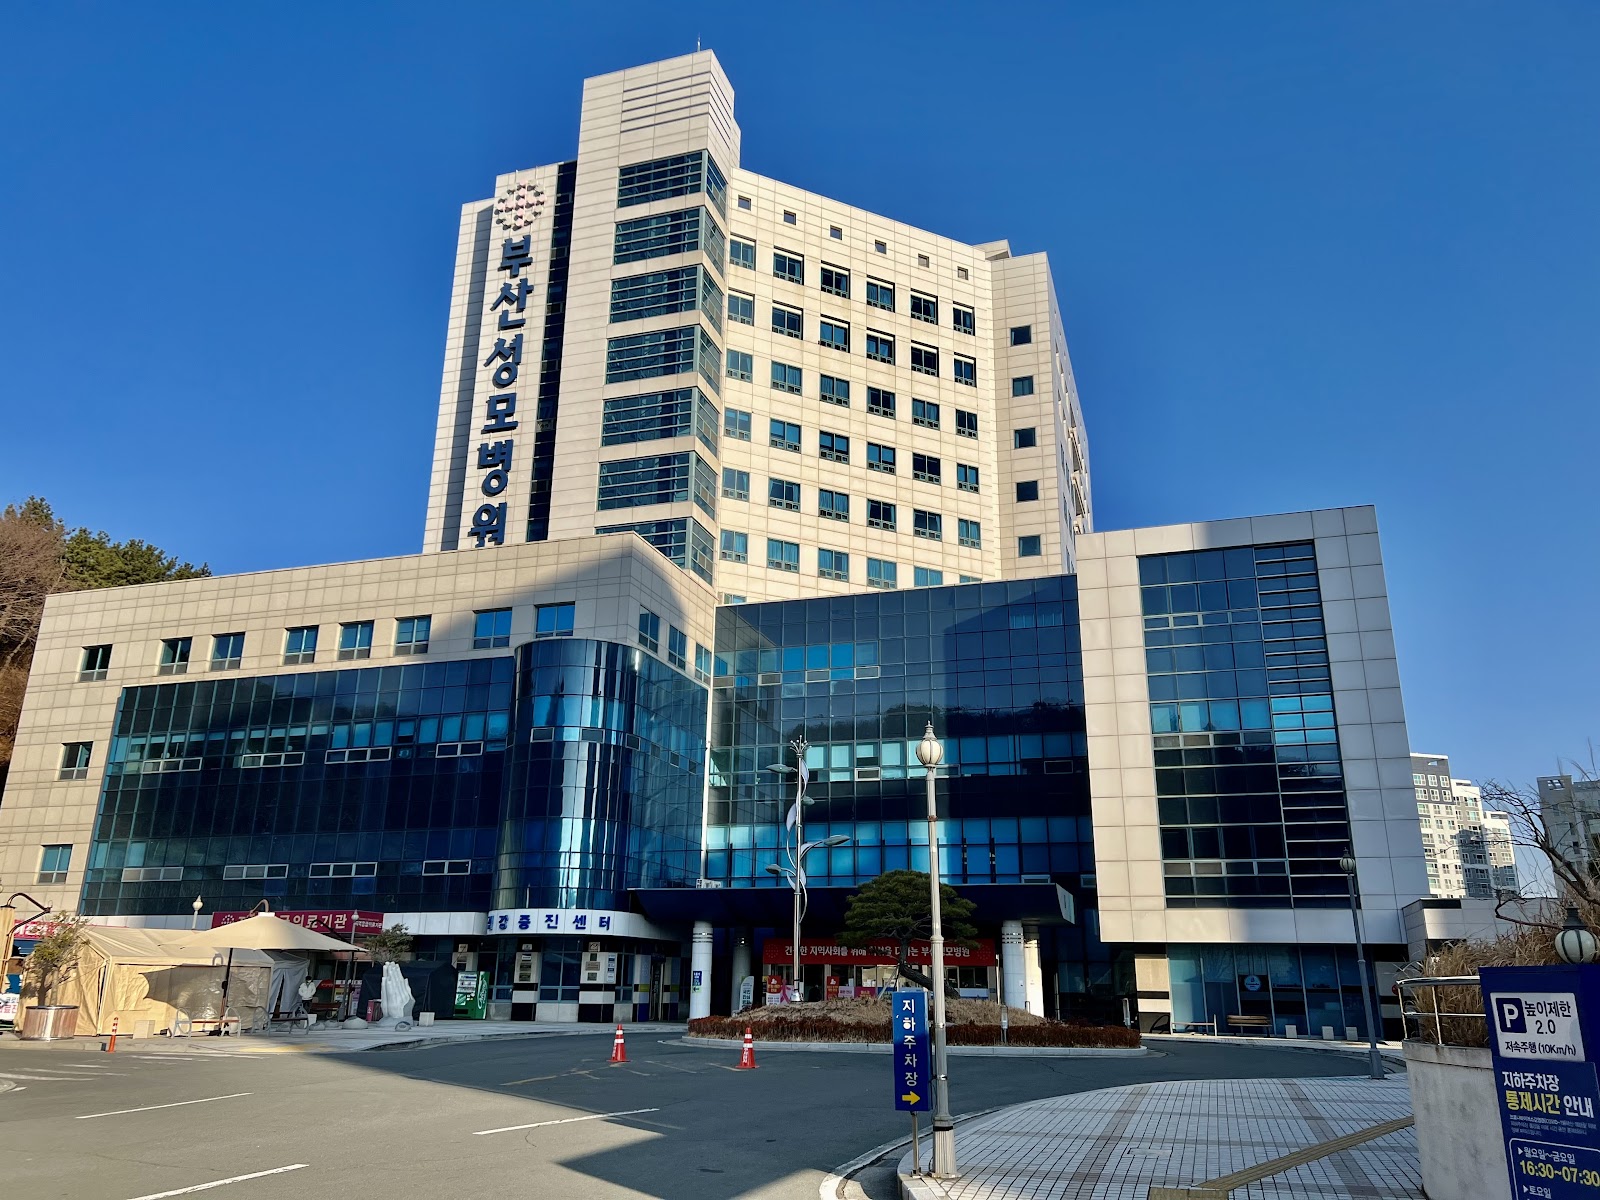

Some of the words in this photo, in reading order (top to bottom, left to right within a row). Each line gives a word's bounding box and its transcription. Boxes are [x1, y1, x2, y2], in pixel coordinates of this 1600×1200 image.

[467, 234, 534, 548] 부산성모병원
[785, 945, 808, 957] 건한
[810, 945, 848, 957] 지역사회를
[1503, 1003, 1519, 1028] P
[1524, 1001, 1571, 1017] 높이제한
[1535, 1019, 1556, 1035] 2.0
[902, 999, 918, 1087] 지하주차장
[1505, 1041, 1537, 1054] 저속주행
[1538, 1042, 1577, 1056] (10Km/h)
[1502, 1071, 1560, 1091] 지하주차장
[1506, 1090, 1560, 1114] 통제시간
[1563, 1095, 1594, 1118] 안내
[1523, 1146, 1576, 1165] 월요일~금요일
[1519, 1160, 1600, 1187] 16:30~07:30
[1529, 1185, 1552, 1199] 토요일
